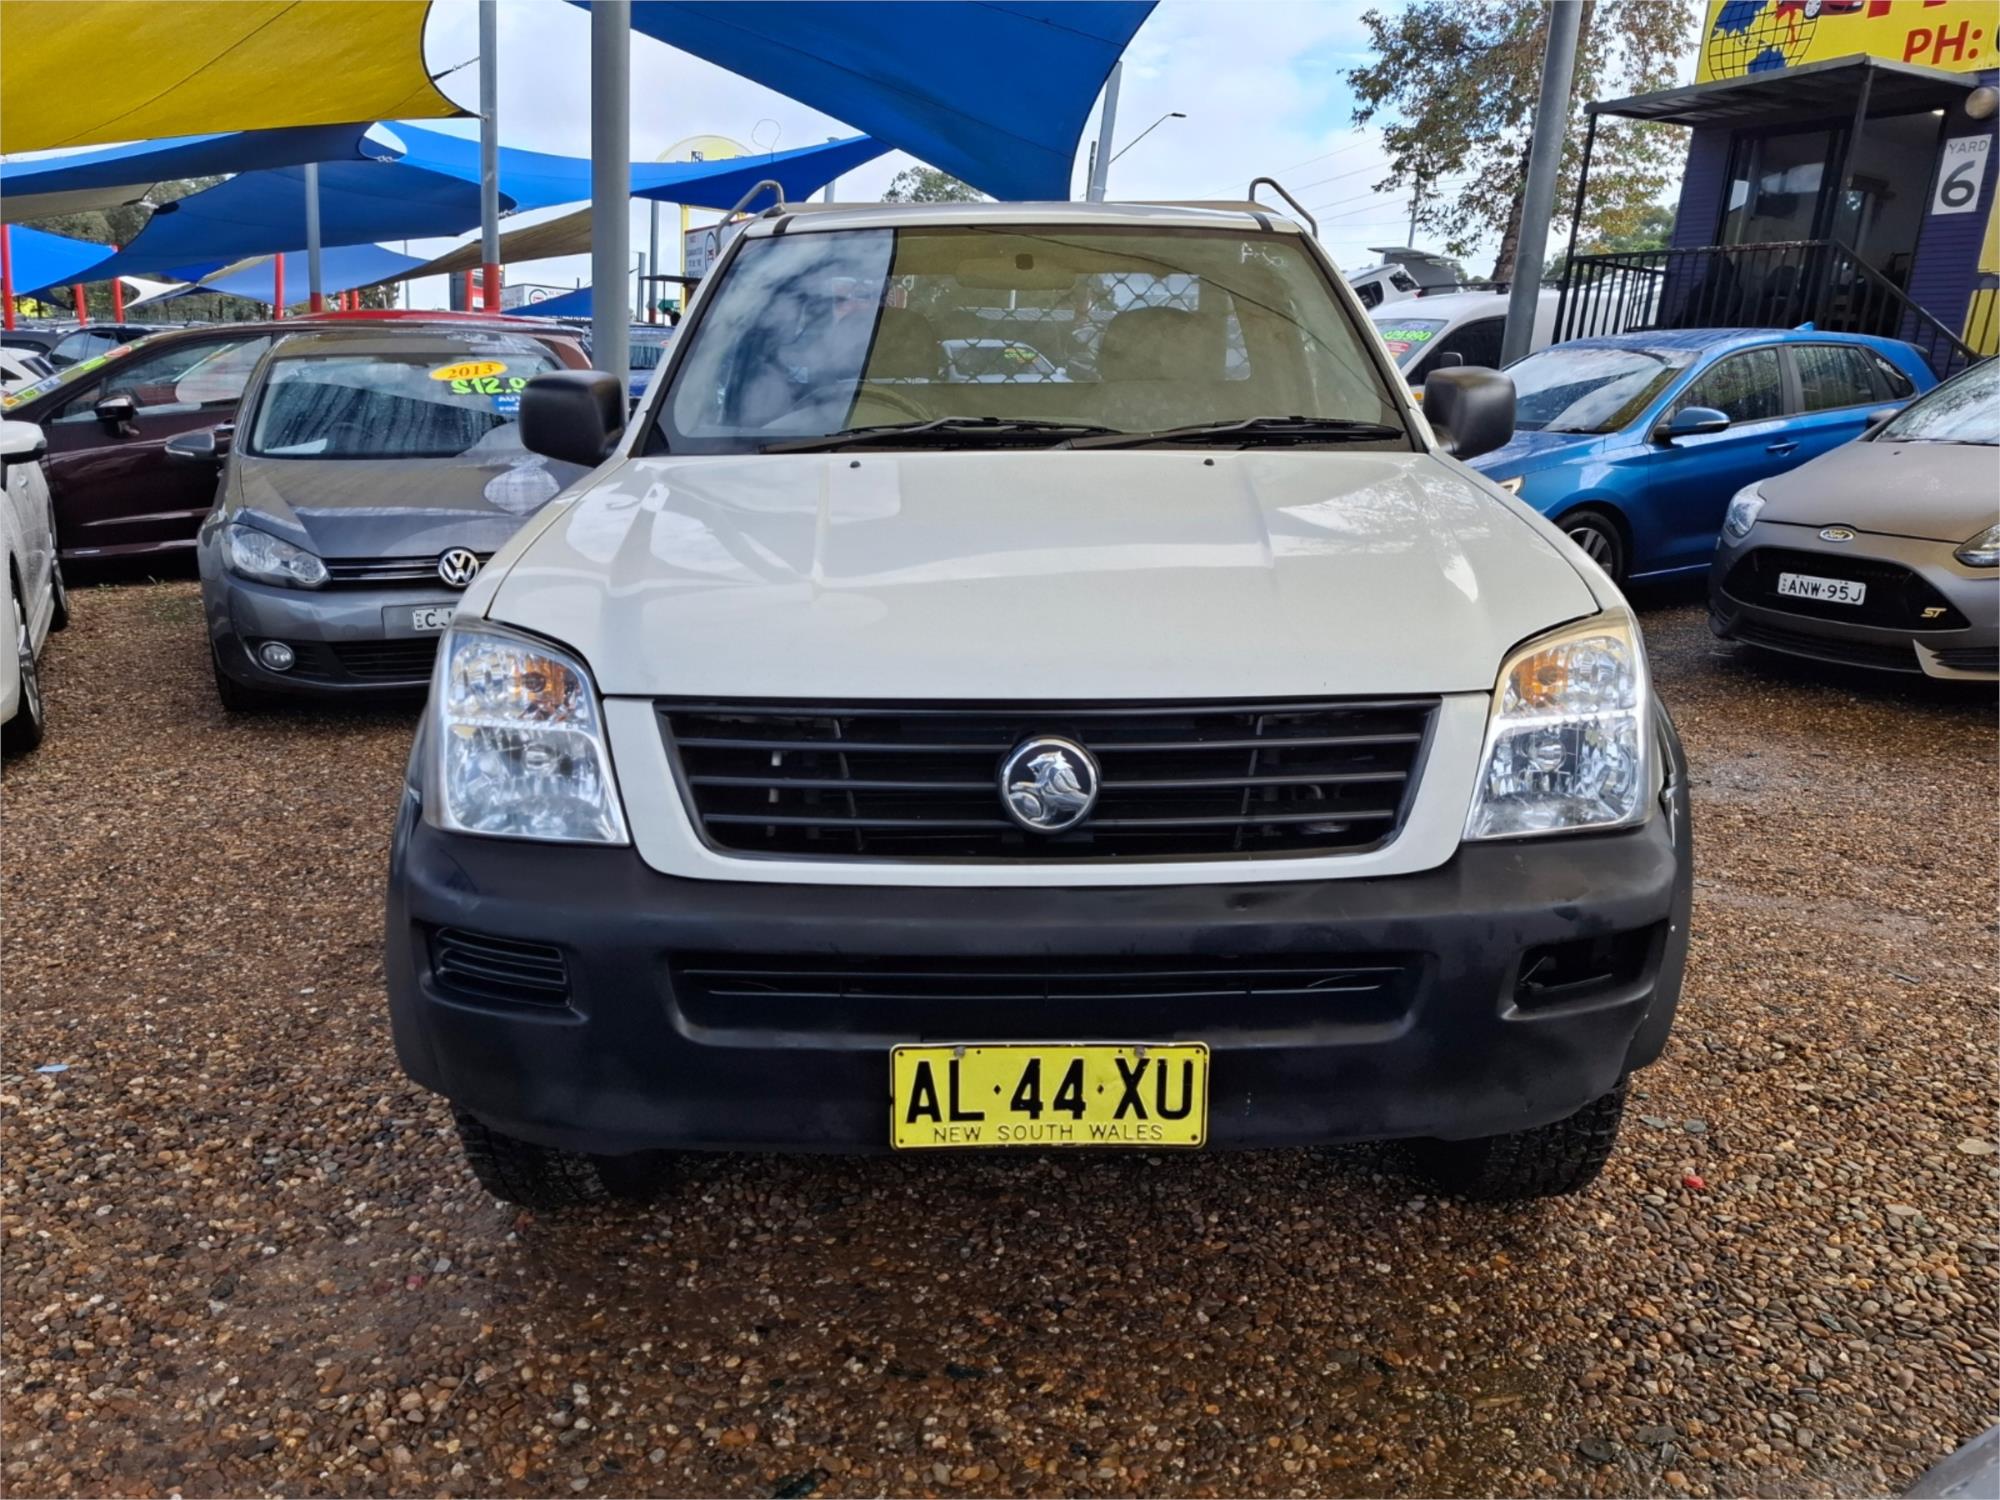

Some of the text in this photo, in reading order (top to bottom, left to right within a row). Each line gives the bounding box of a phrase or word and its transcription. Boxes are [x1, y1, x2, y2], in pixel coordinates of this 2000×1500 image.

[1903, 20, 1983, 65] PH:
[1949, 140, 1988, 154] YARD
[1941, 161, 1975, 208] 6
[448, 364, 493, 379] 2013
[1920, 607, 1947, 618] ST
[934, 1124, 1163, 1142] NEW SOUTH WALES
